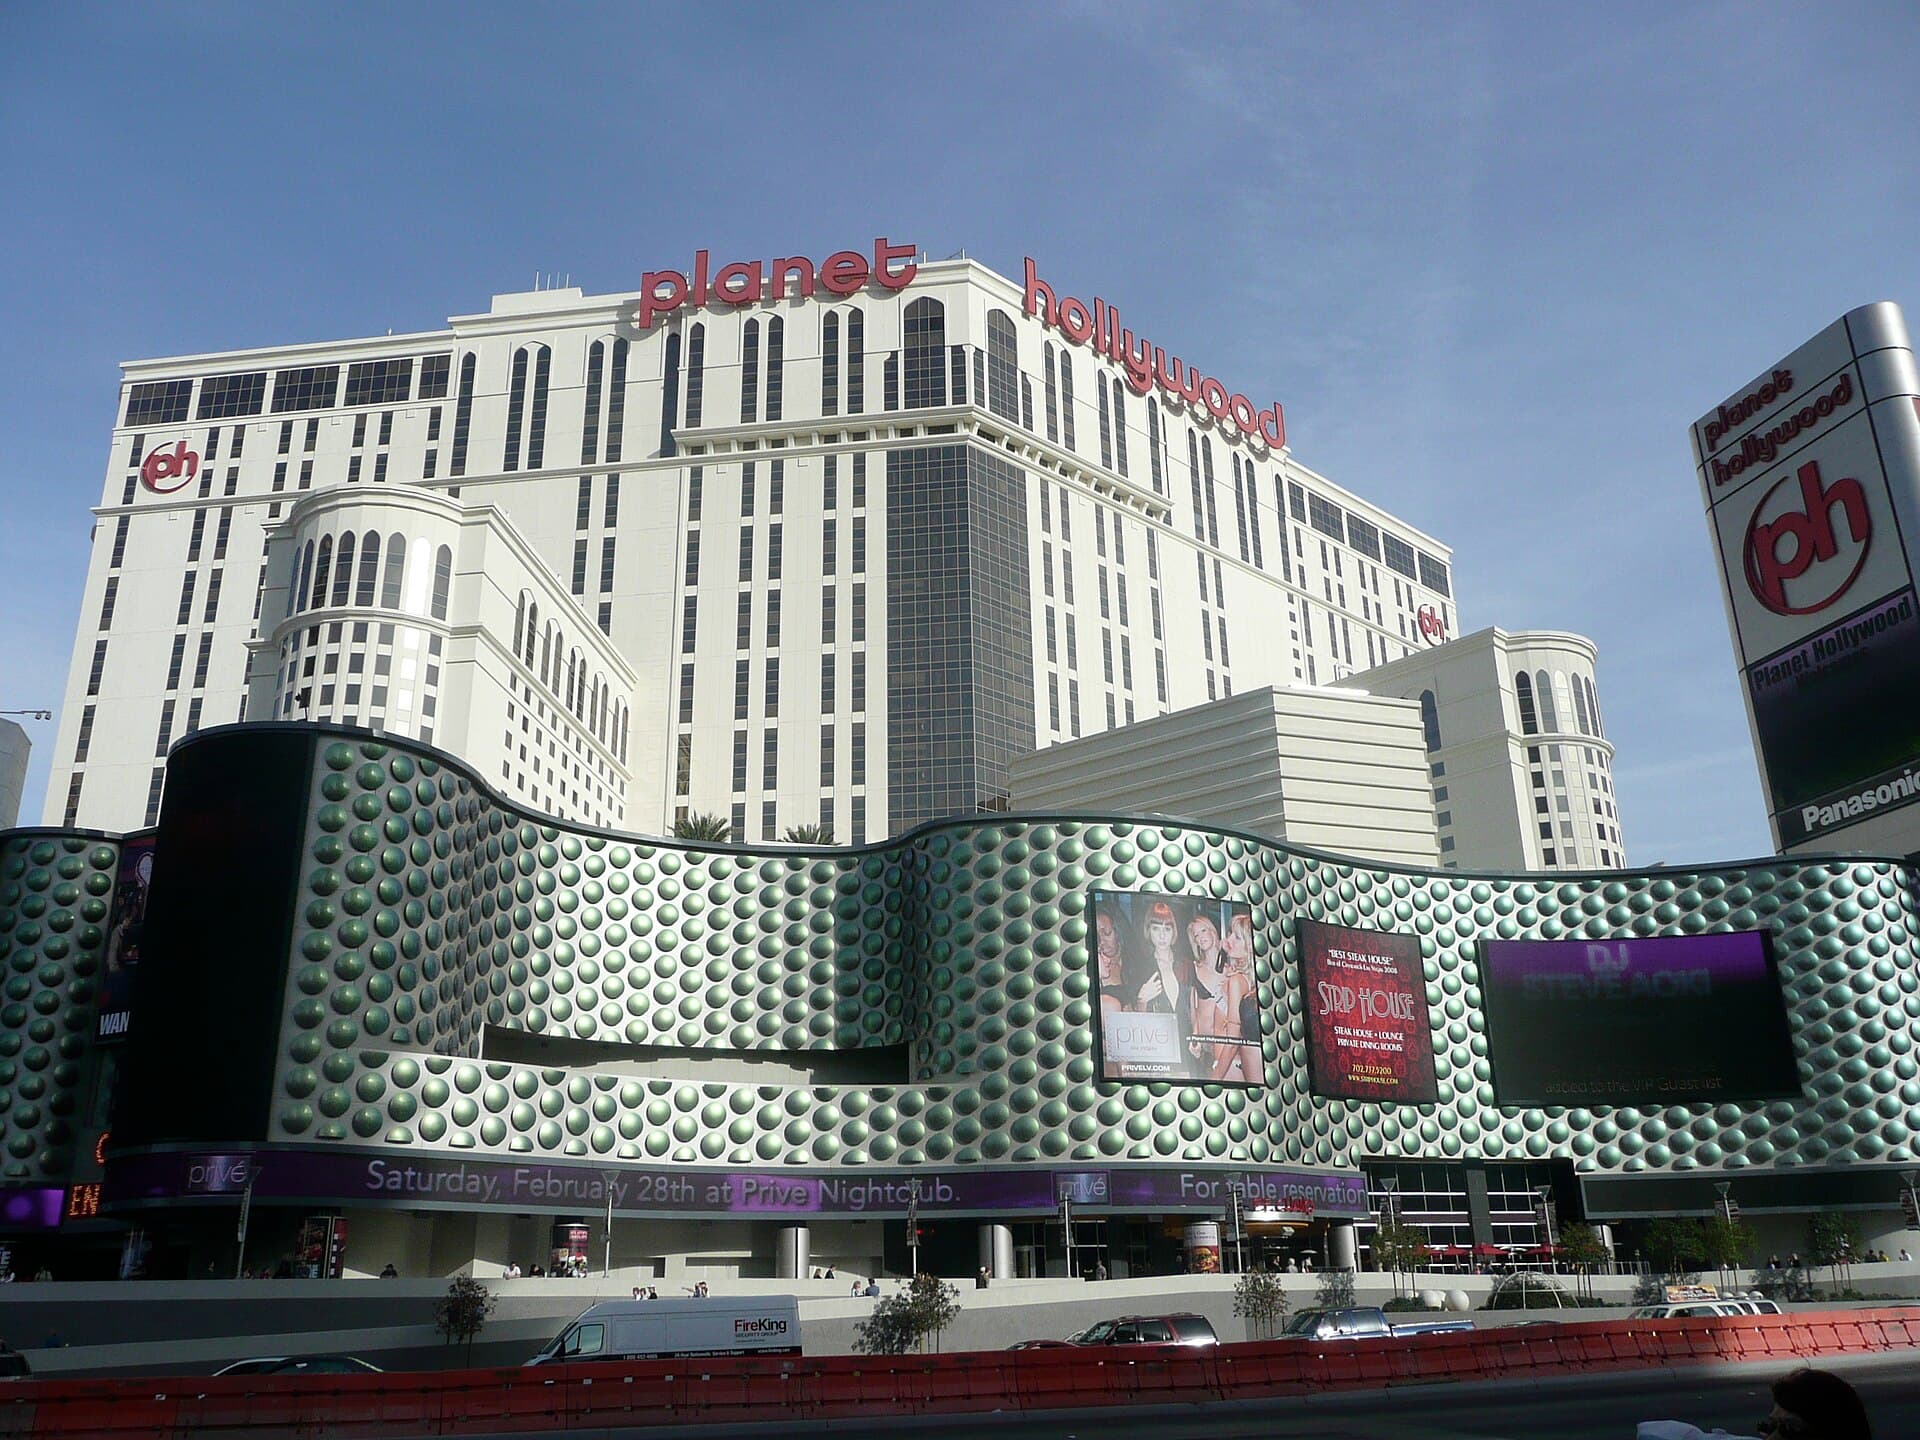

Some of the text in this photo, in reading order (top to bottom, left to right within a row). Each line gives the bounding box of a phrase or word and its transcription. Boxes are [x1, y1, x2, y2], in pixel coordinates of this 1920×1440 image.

[639, 237, 1285, 449] planet hollywood
[1704, 369, 1793, 452] planet
[1711, 373, 1853, 486] hollywood
[146, 440, 199, 489] ph
[1754, 460, 1868, 608] ph
[1420, 605, 1444, 640] ph
[1754, 649, 1808, 690] Planet
[1812, 596, 1912, 660] Hollywood
[1346, 952, 1367, 963] STEAK
[1586, 943, 1630, 971] DJ
[1359, 988, 1415, 1024] HOUSE
[1334, 1026, 1352, 1036] STEAK
[1353, 1029, 1374, 1039] HOUSE
[1337, 1038, 1359, 1048] PRIVATE
[187, 1160, 247, 1188] privé
[367, 1160, 501, 1202] Saturday,
[637, 1176, 695, 1201] 28th
[705, 1180, 732, 1201] at
[743, 1180, 807, 1205] Prive
[1180, 1174, 1223, 1198] For
[735, 1318, 787, 1333] FireKing
